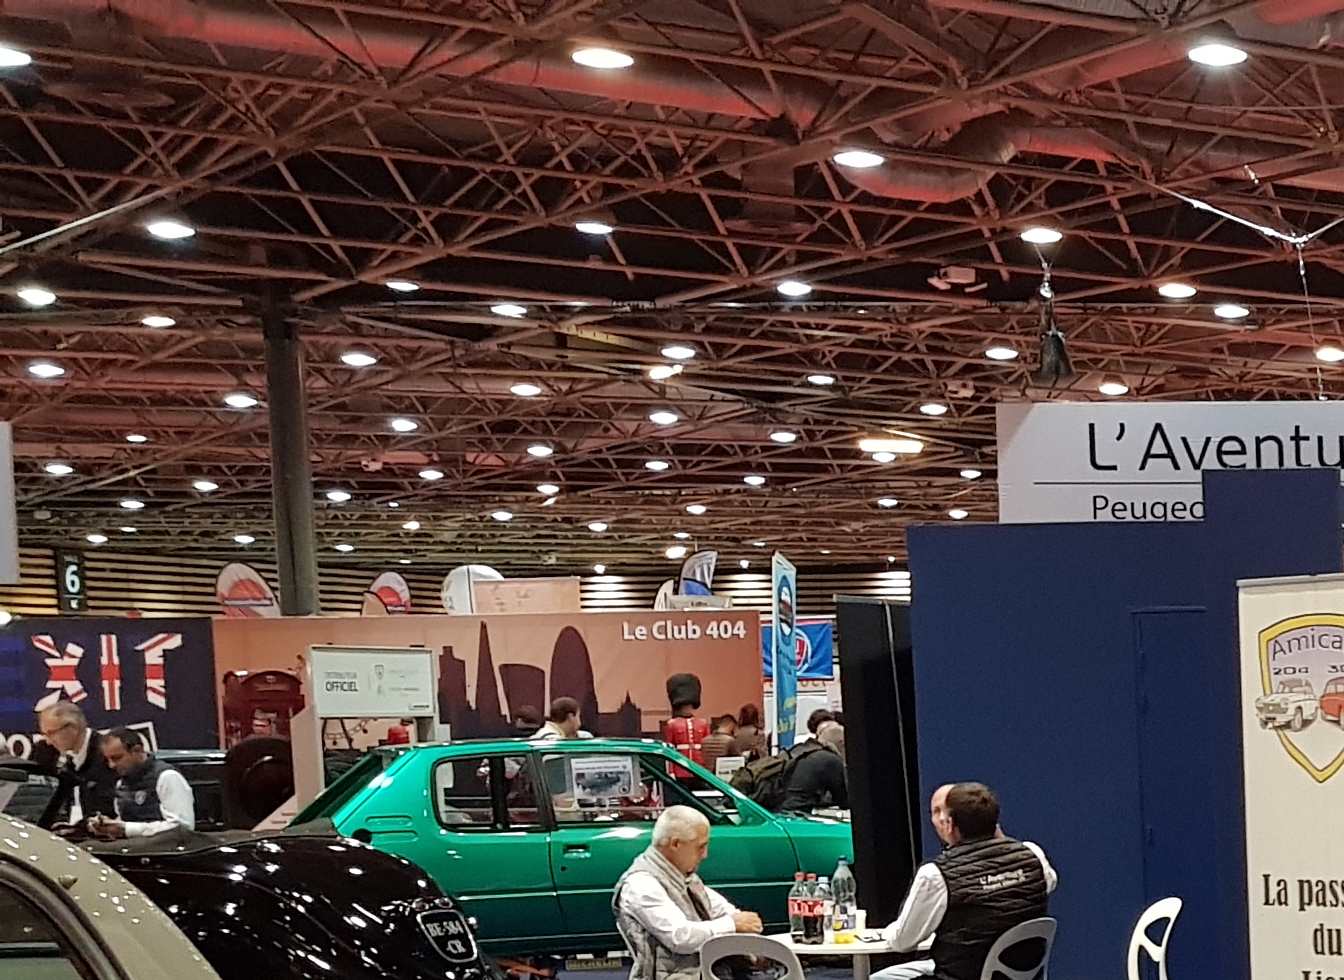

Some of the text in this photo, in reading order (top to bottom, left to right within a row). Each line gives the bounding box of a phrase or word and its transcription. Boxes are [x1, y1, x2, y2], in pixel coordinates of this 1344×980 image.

[1092, 494, 1206, 522] Peugeo
[65, 564, 81, 593] 6
[622, 620, 747, 641] Le Club 404
[1262, 873, 1289, 907] La
[1312, 923, 1343, 956] du
